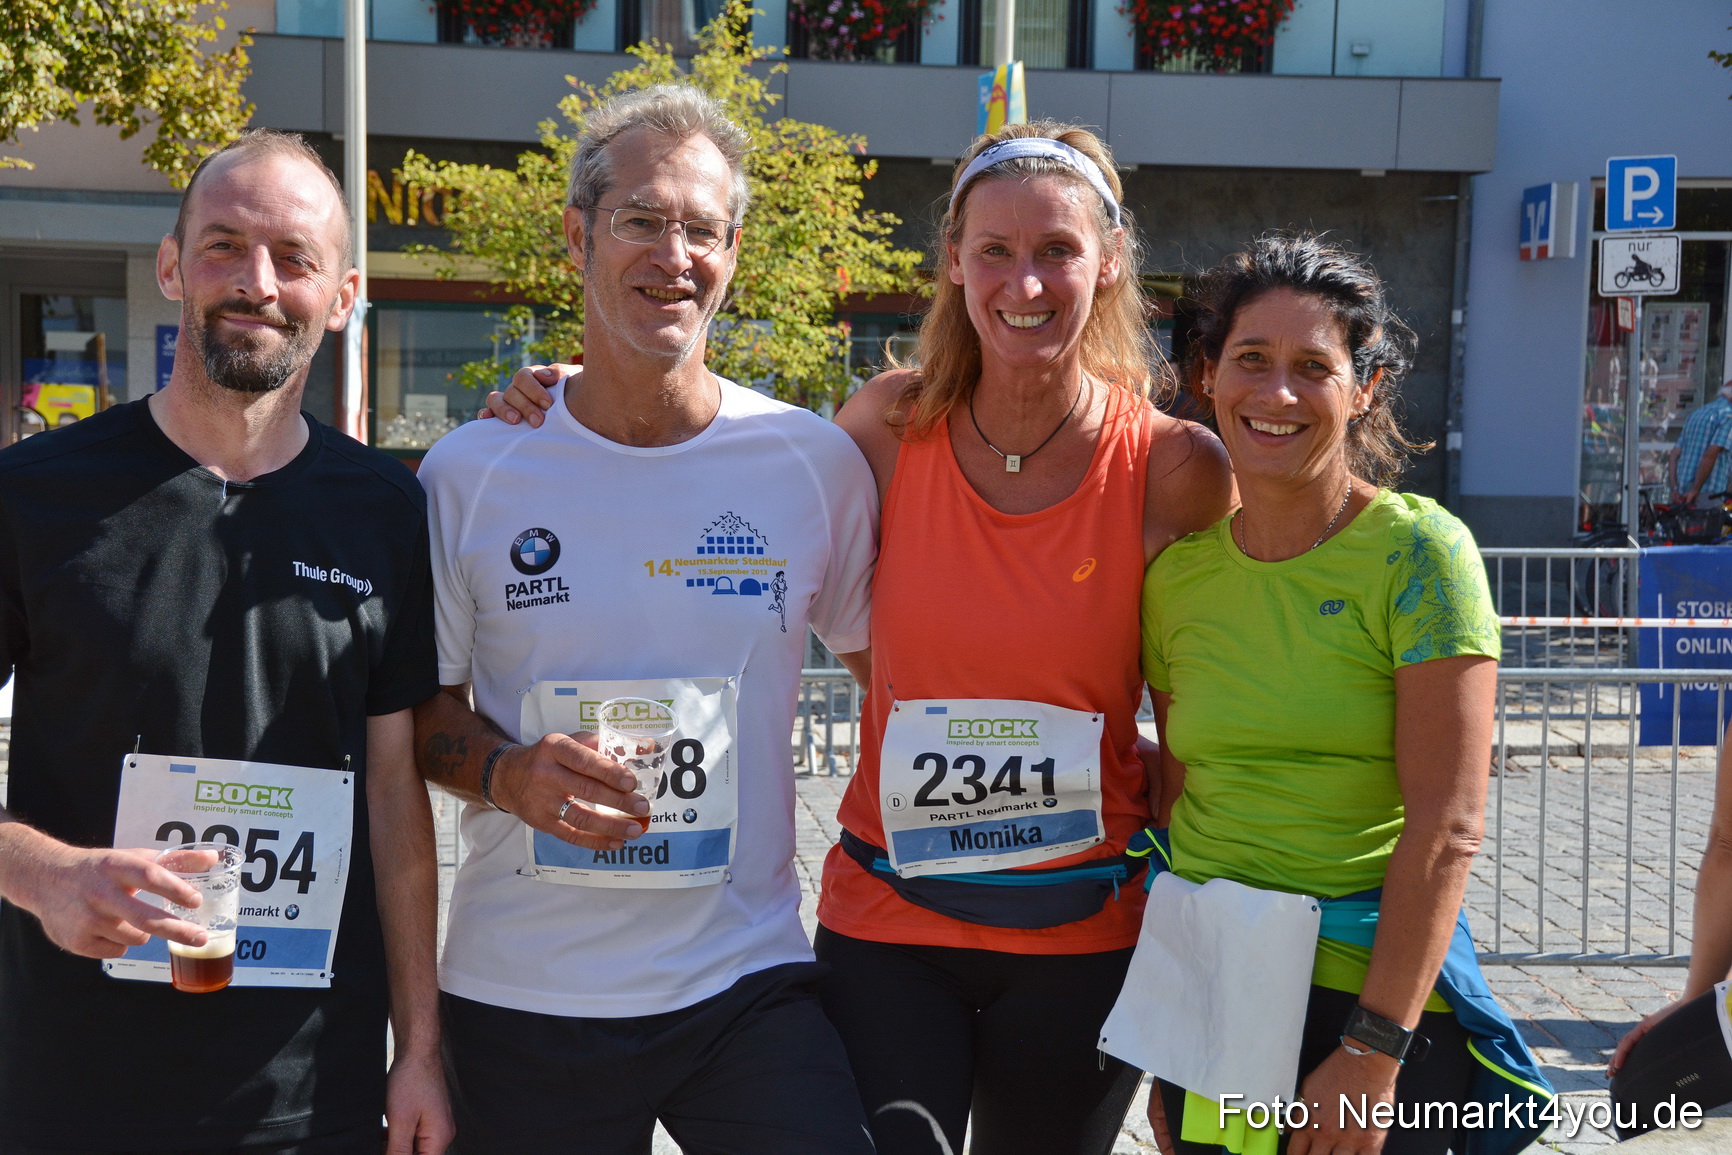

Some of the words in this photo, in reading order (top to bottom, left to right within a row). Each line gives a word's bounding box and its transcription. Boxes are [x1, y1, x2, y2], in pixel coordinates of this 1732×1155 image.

[1623, 166, 1660, 221] P
[1628, 241, 1653, 252] nur
[292, 561, 328, 582] Thule
[644, 559, 681, 577] 14.
[675, 557, 739, 567] Neumarkter
[742, 557, 788, 567] Stadtlauf
[505, 576, 570, 600] PARTL
[506, 592, 570, 611] Neumarkt
[948, 718, 1039, 738] BOCK
[946, 739, 975, 747] inspired
[976, 739, 985, 747] by
[912, 752, 1056, 808] 2341
[195, 780, 295, 810] BOCK
[893, 798, 900, 807] D
[193, 803, 226, 813] inspired
[228, 806, 238, 815] by
[240, 808, 262, 816] smart
[264, 810, 293, 819] concepts
[930, 811, 975, 822] PARTL
[977, 801, 1038, 817] Neumarkt
[950, 824, 1043, 851] Monika
